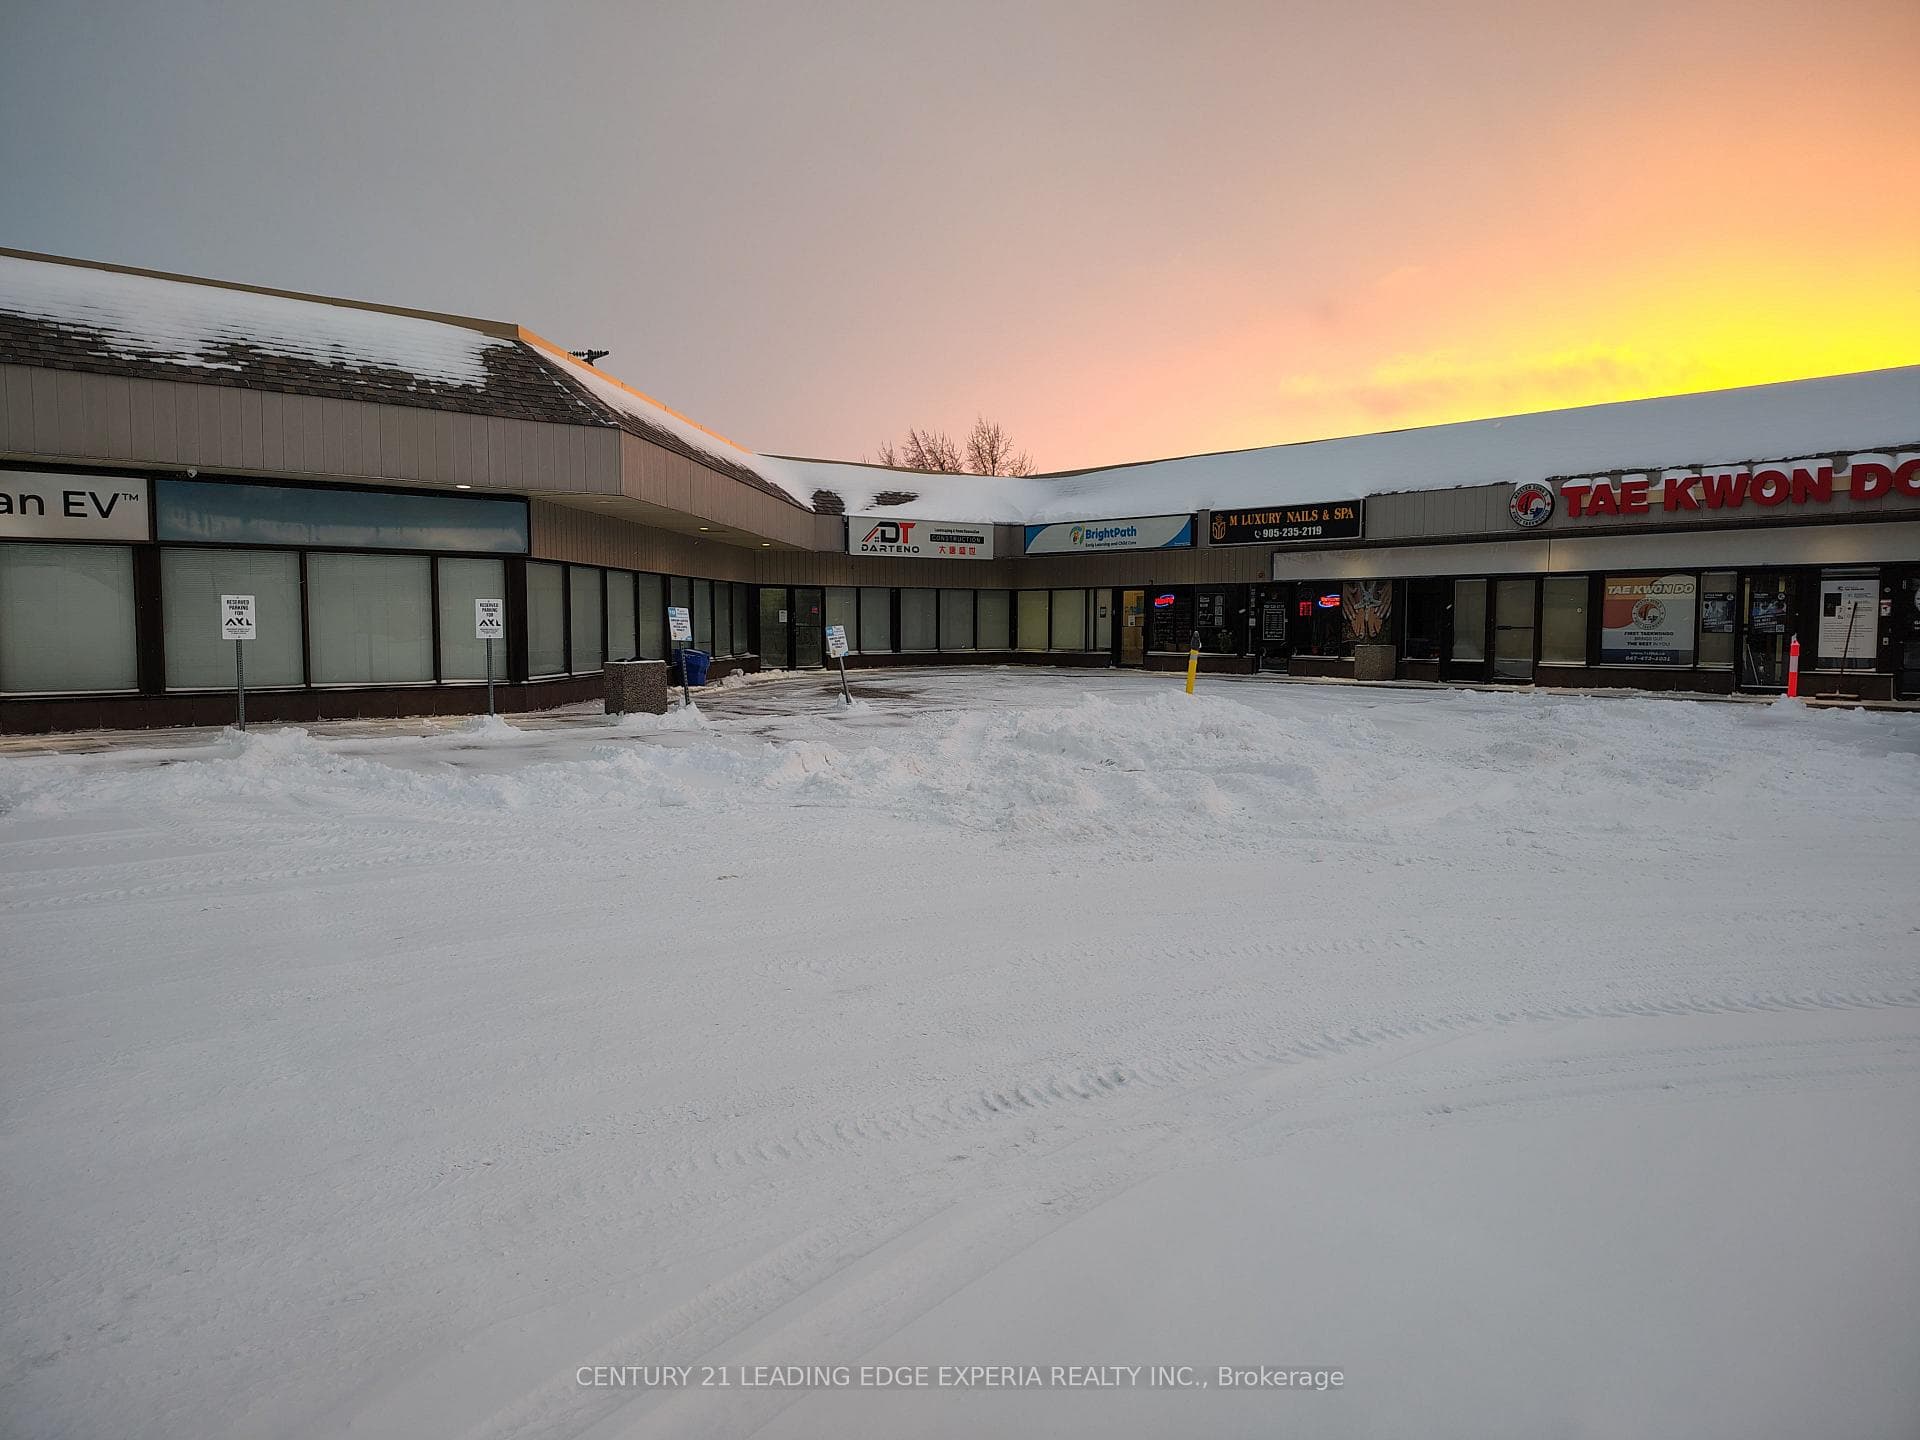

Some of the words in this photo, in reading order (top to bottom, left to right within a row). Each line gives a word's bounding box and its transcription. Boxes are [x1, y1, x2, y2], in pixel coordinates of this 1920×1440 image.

[1561, 481, 1649, 517] TAE
[1663, 466, 1834, 511] KWON
[1229, 514, 1238, 526] M
[1241, 512, 1282, 526] LUXURY
[1286, 509, 1319, 523] NAILS
[1322, 509, 1330, 521] &
[1333, 507, 1354, 520] SPA
[1085, 525, 1137, 541] BrightPath
[1262, 525, 1323, 538] 905-235-2119
[931, 535, 981, 543] CONSTRUCTION
[861, 544, 920, 553] DARTENO
[1607, 585, 1632, 595] TAE
[1632, 583, 1673, 594] KWON
[1673, 583, 1695, 594] DO
[225, 617, 253, 626] AXL
